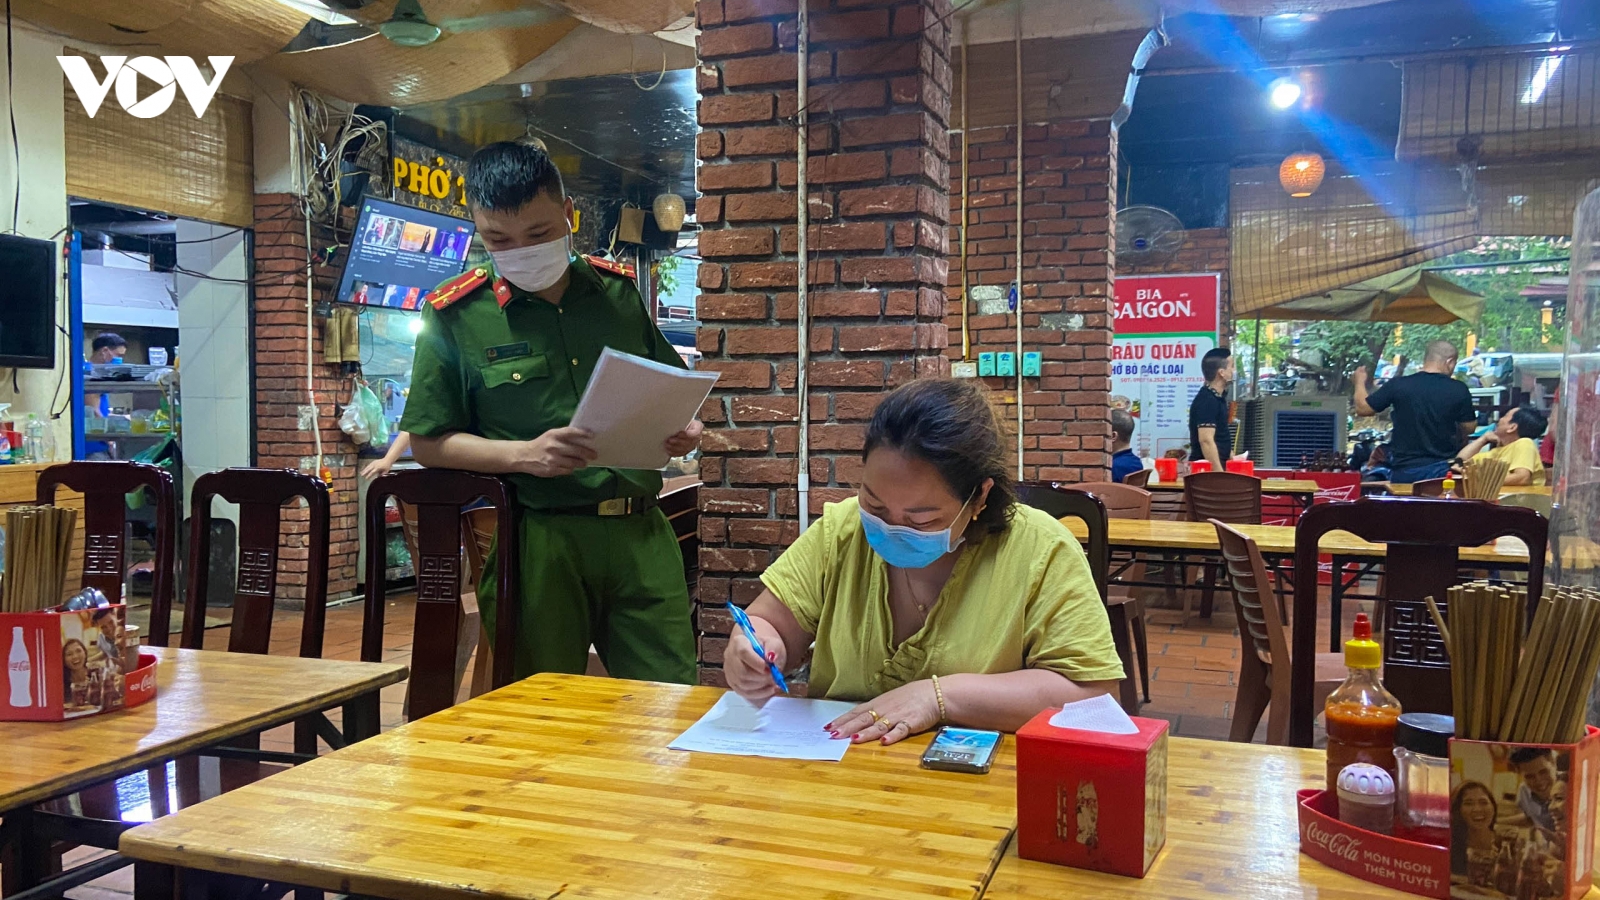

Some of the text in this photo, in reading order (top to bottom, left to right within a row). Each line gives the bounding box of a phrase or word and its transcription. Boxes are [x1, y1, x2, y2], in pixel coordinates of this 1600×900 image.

[393, 156, 452, 199] PHỞ
[1136, 289, 1162, 300] BIA
[1151, 341, 1197, 360] QUÁN
[1125, 363, 1138, 375] BÒ
[1162, 364, 1184, 377] LOẠI
[1306, 821, 1363, 862] Coca-Cola
[1393, 858, 1432, 875] NGON
